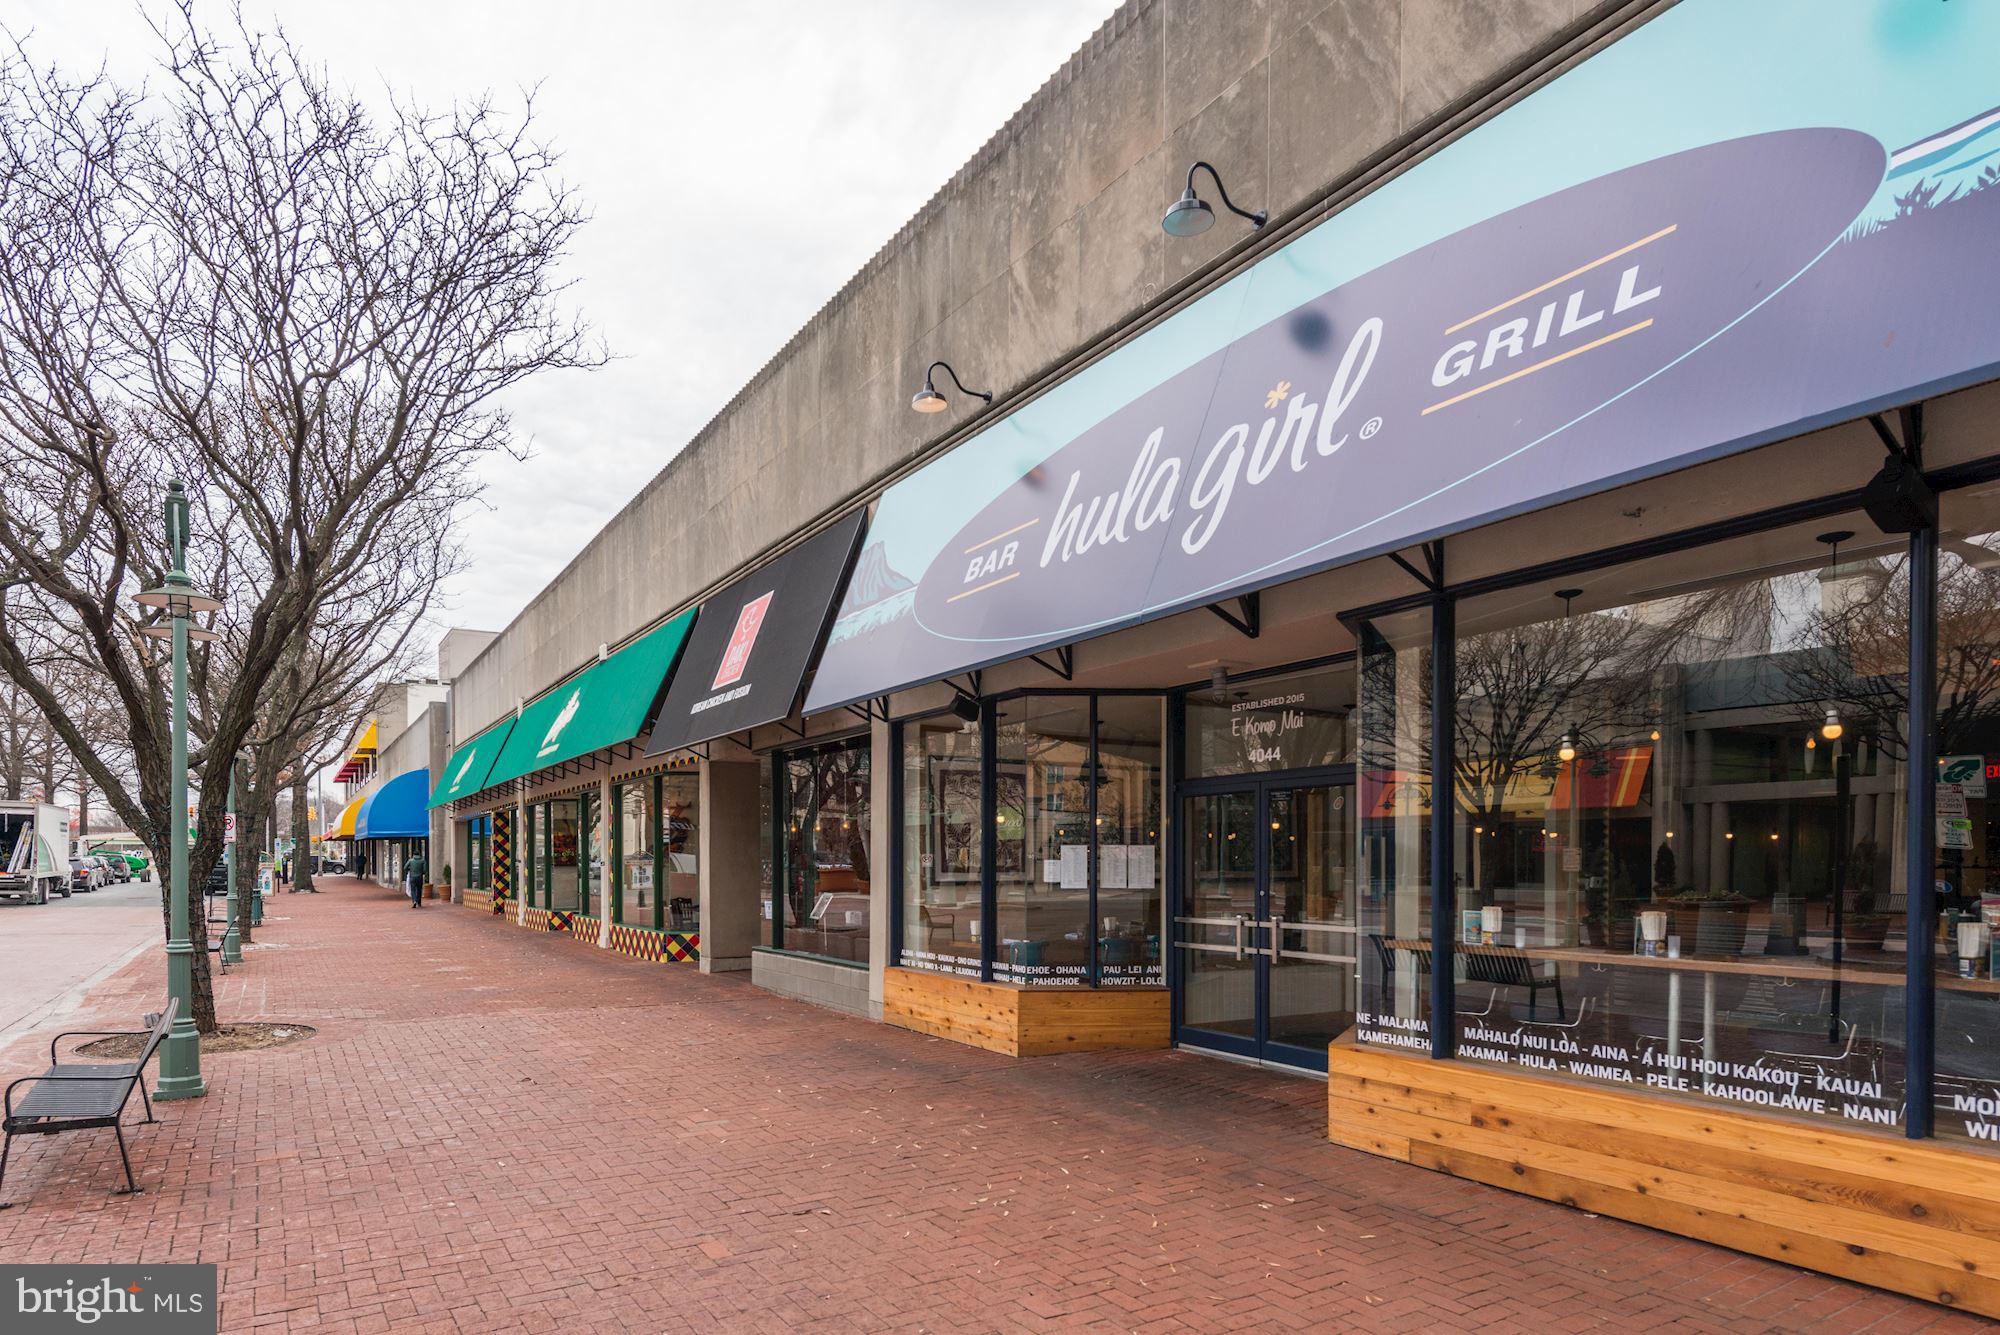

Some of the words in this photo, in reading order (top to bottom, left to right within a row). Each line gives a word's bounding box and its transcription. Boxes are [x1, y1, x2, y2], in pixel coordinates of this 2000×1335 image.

[1432, 266, 1662, 387] GRILL
[1039, 426, 1182, 568] hula
[1181, 317, 1383, 555] girl
[964, 540, 1019, 584] BAR
[1232, 696, 1284, 712] ESTABLISHED
[1286, 693, 1304, 704] 2015
[1231, 717, 1241, 737] E
[1277, 710, 1304, 737] Mai
[1248, 746, 1281, 763] 4044
[1055, 966, 1087, 975] OHANA
[1103, 965, 1121, 974] PAU
[1032, 977, 1080, 986] PAHOEHOE
[1378, 1014, 1429, 1032] MALAMA
[1464, 1026, 1520, 1046] MAHALO
[1522, 1034, 1548, 1050] NUI
[1551, 1038, 1580, 1054] LOA
[1591, 1044, 1629, 1062] AINA
[1657, 1052, 1687, 1070] HUI
[1691, 1057, 1730, 1077] HOU
[1732, 1064, 1799, 1086] KAKOU
[1817, 1075, 1882, 1099] KAUAI
[1458, 1044, 1508, 1064] AKAMAI
[1520, 1053, 1558, 1071] HULA
[1569, 1060, 1633, 1084] WAIMEA
[1646, 1072, 1688, 1092] PELE
[1703, 1081, 1826, 1114] KAHOOLAWE
[1843, 1103, 1897, 1126] NANI
[1954, 1094, 2000, 1117] MO
[1964, 1120, 2000, 1142] WI
